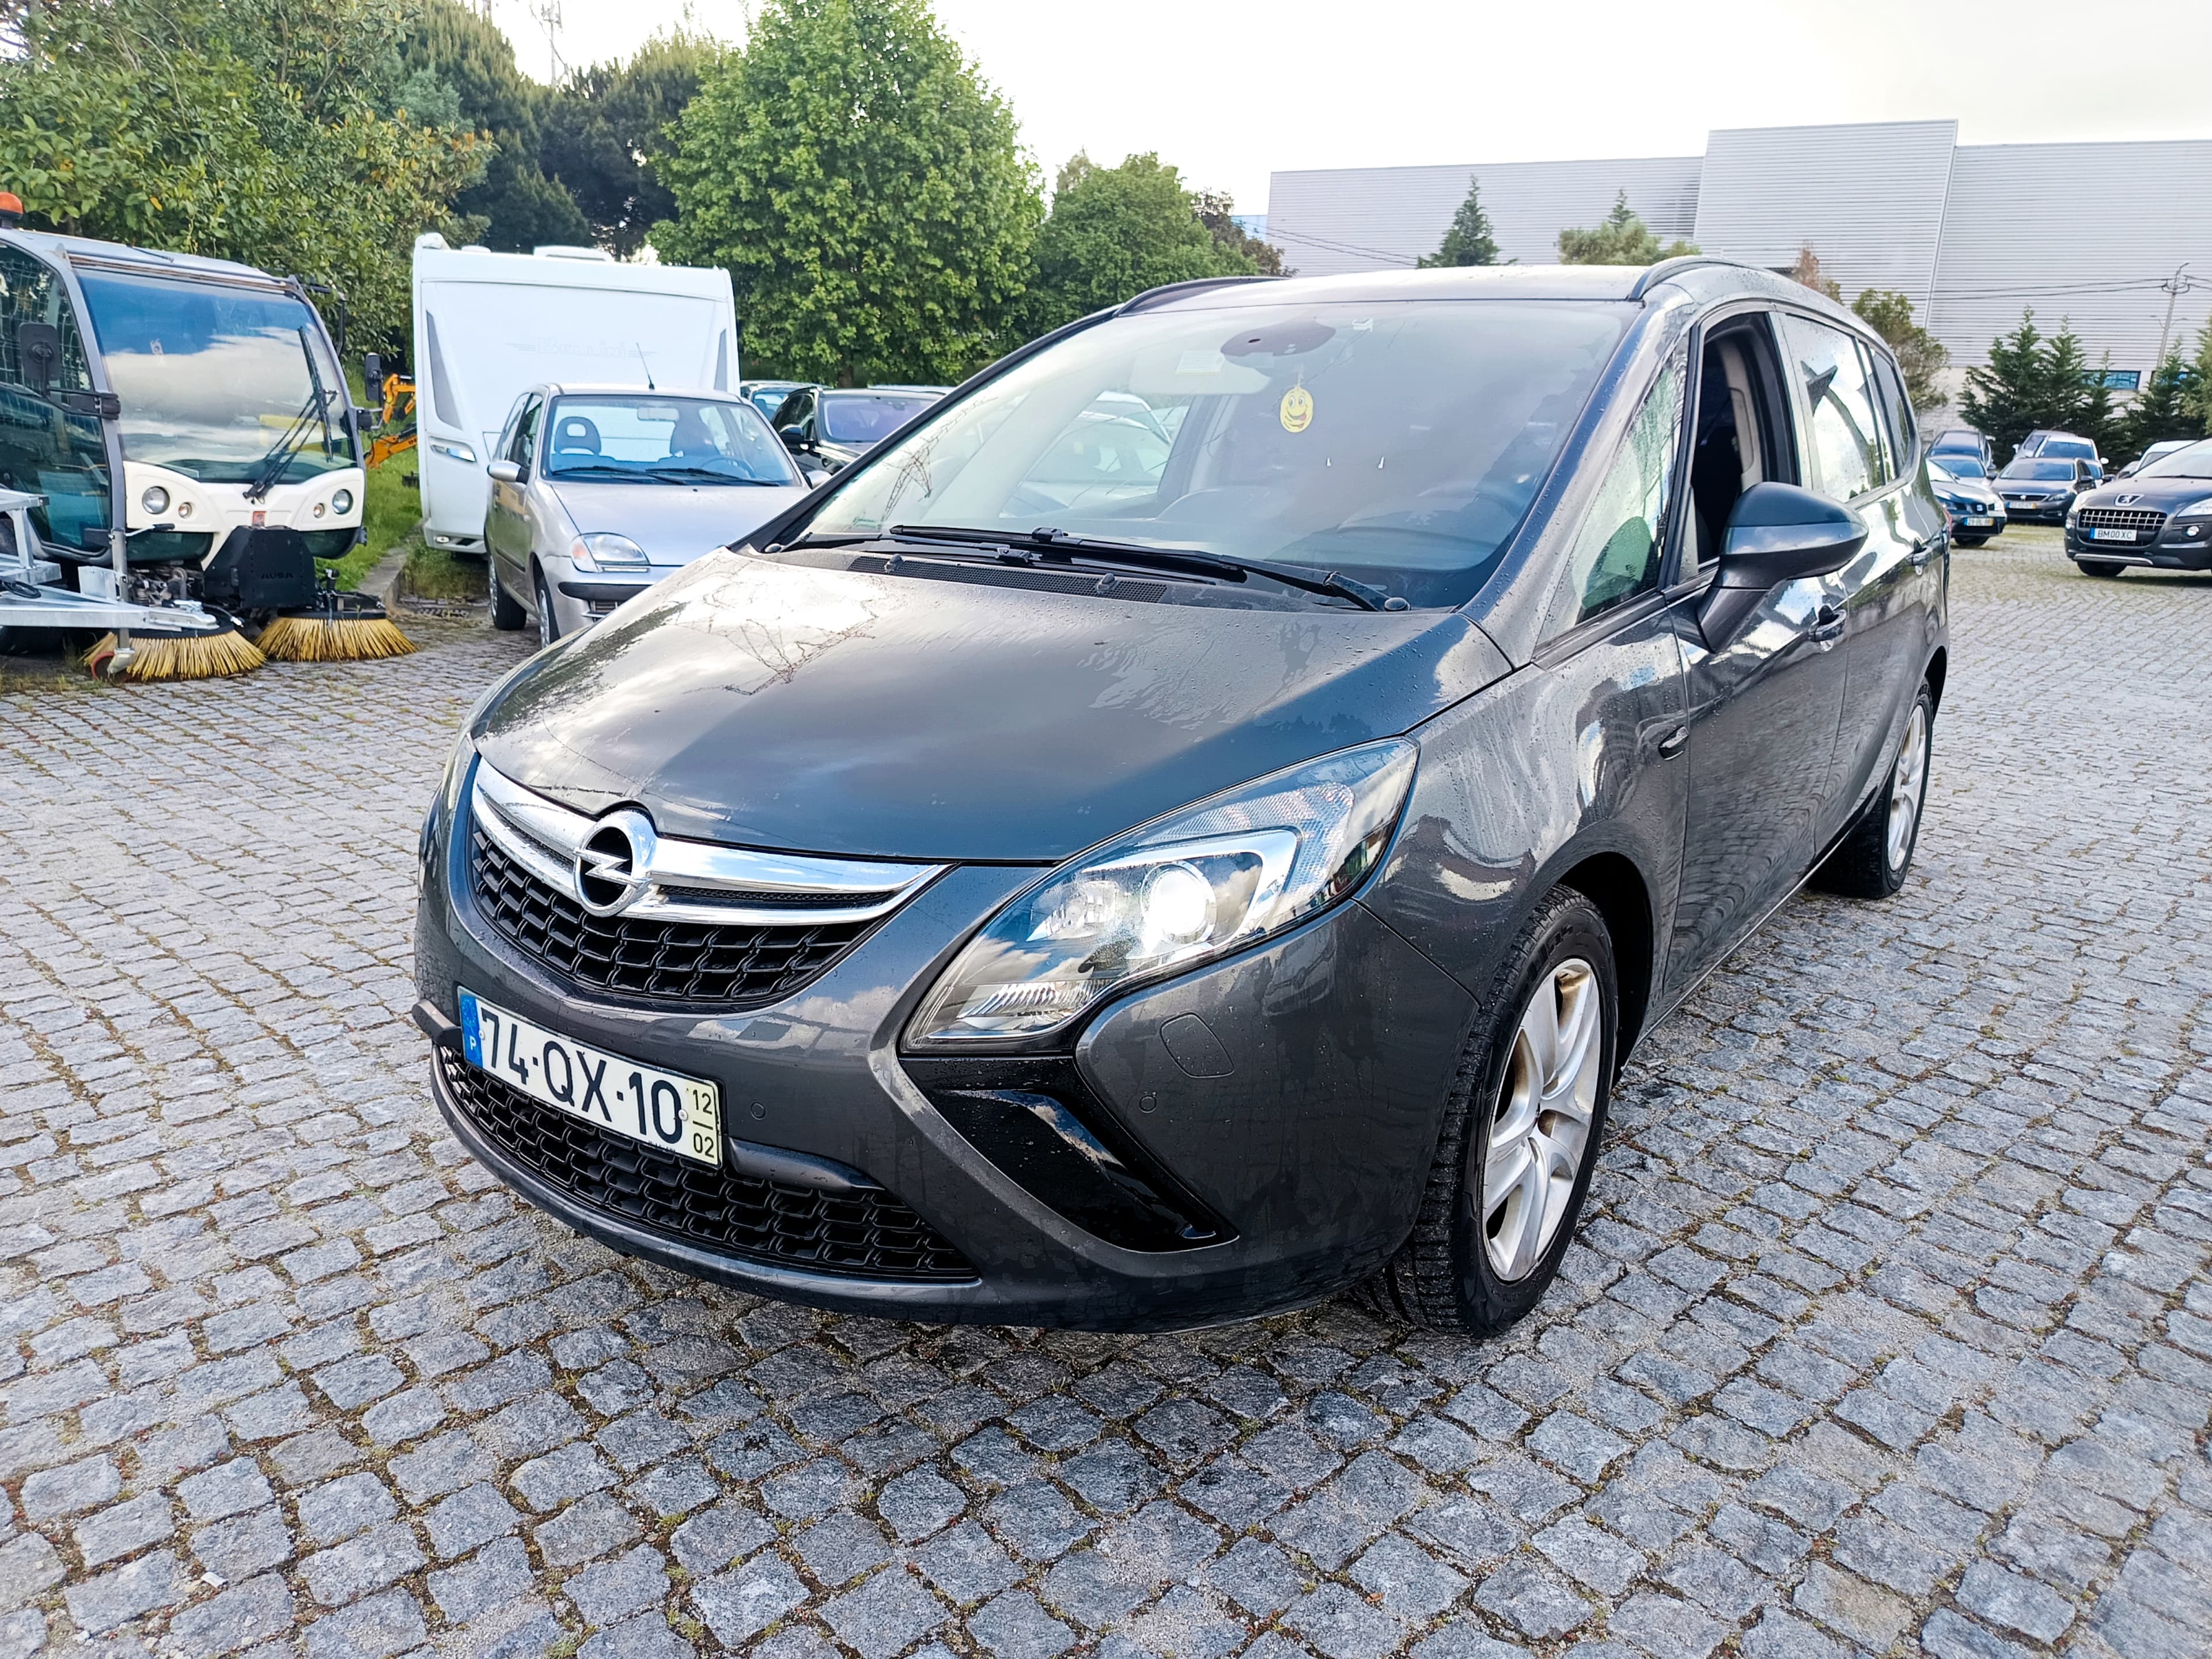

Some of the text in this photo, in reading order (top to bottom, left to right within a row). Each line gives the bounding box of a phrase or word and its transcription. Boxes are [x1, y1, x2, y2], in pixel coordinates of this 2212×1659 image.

[469, 1035, 476, 1051] P
[692, 1089, 713, 1115] 12
[693, 1132, 714, 1158] 02
